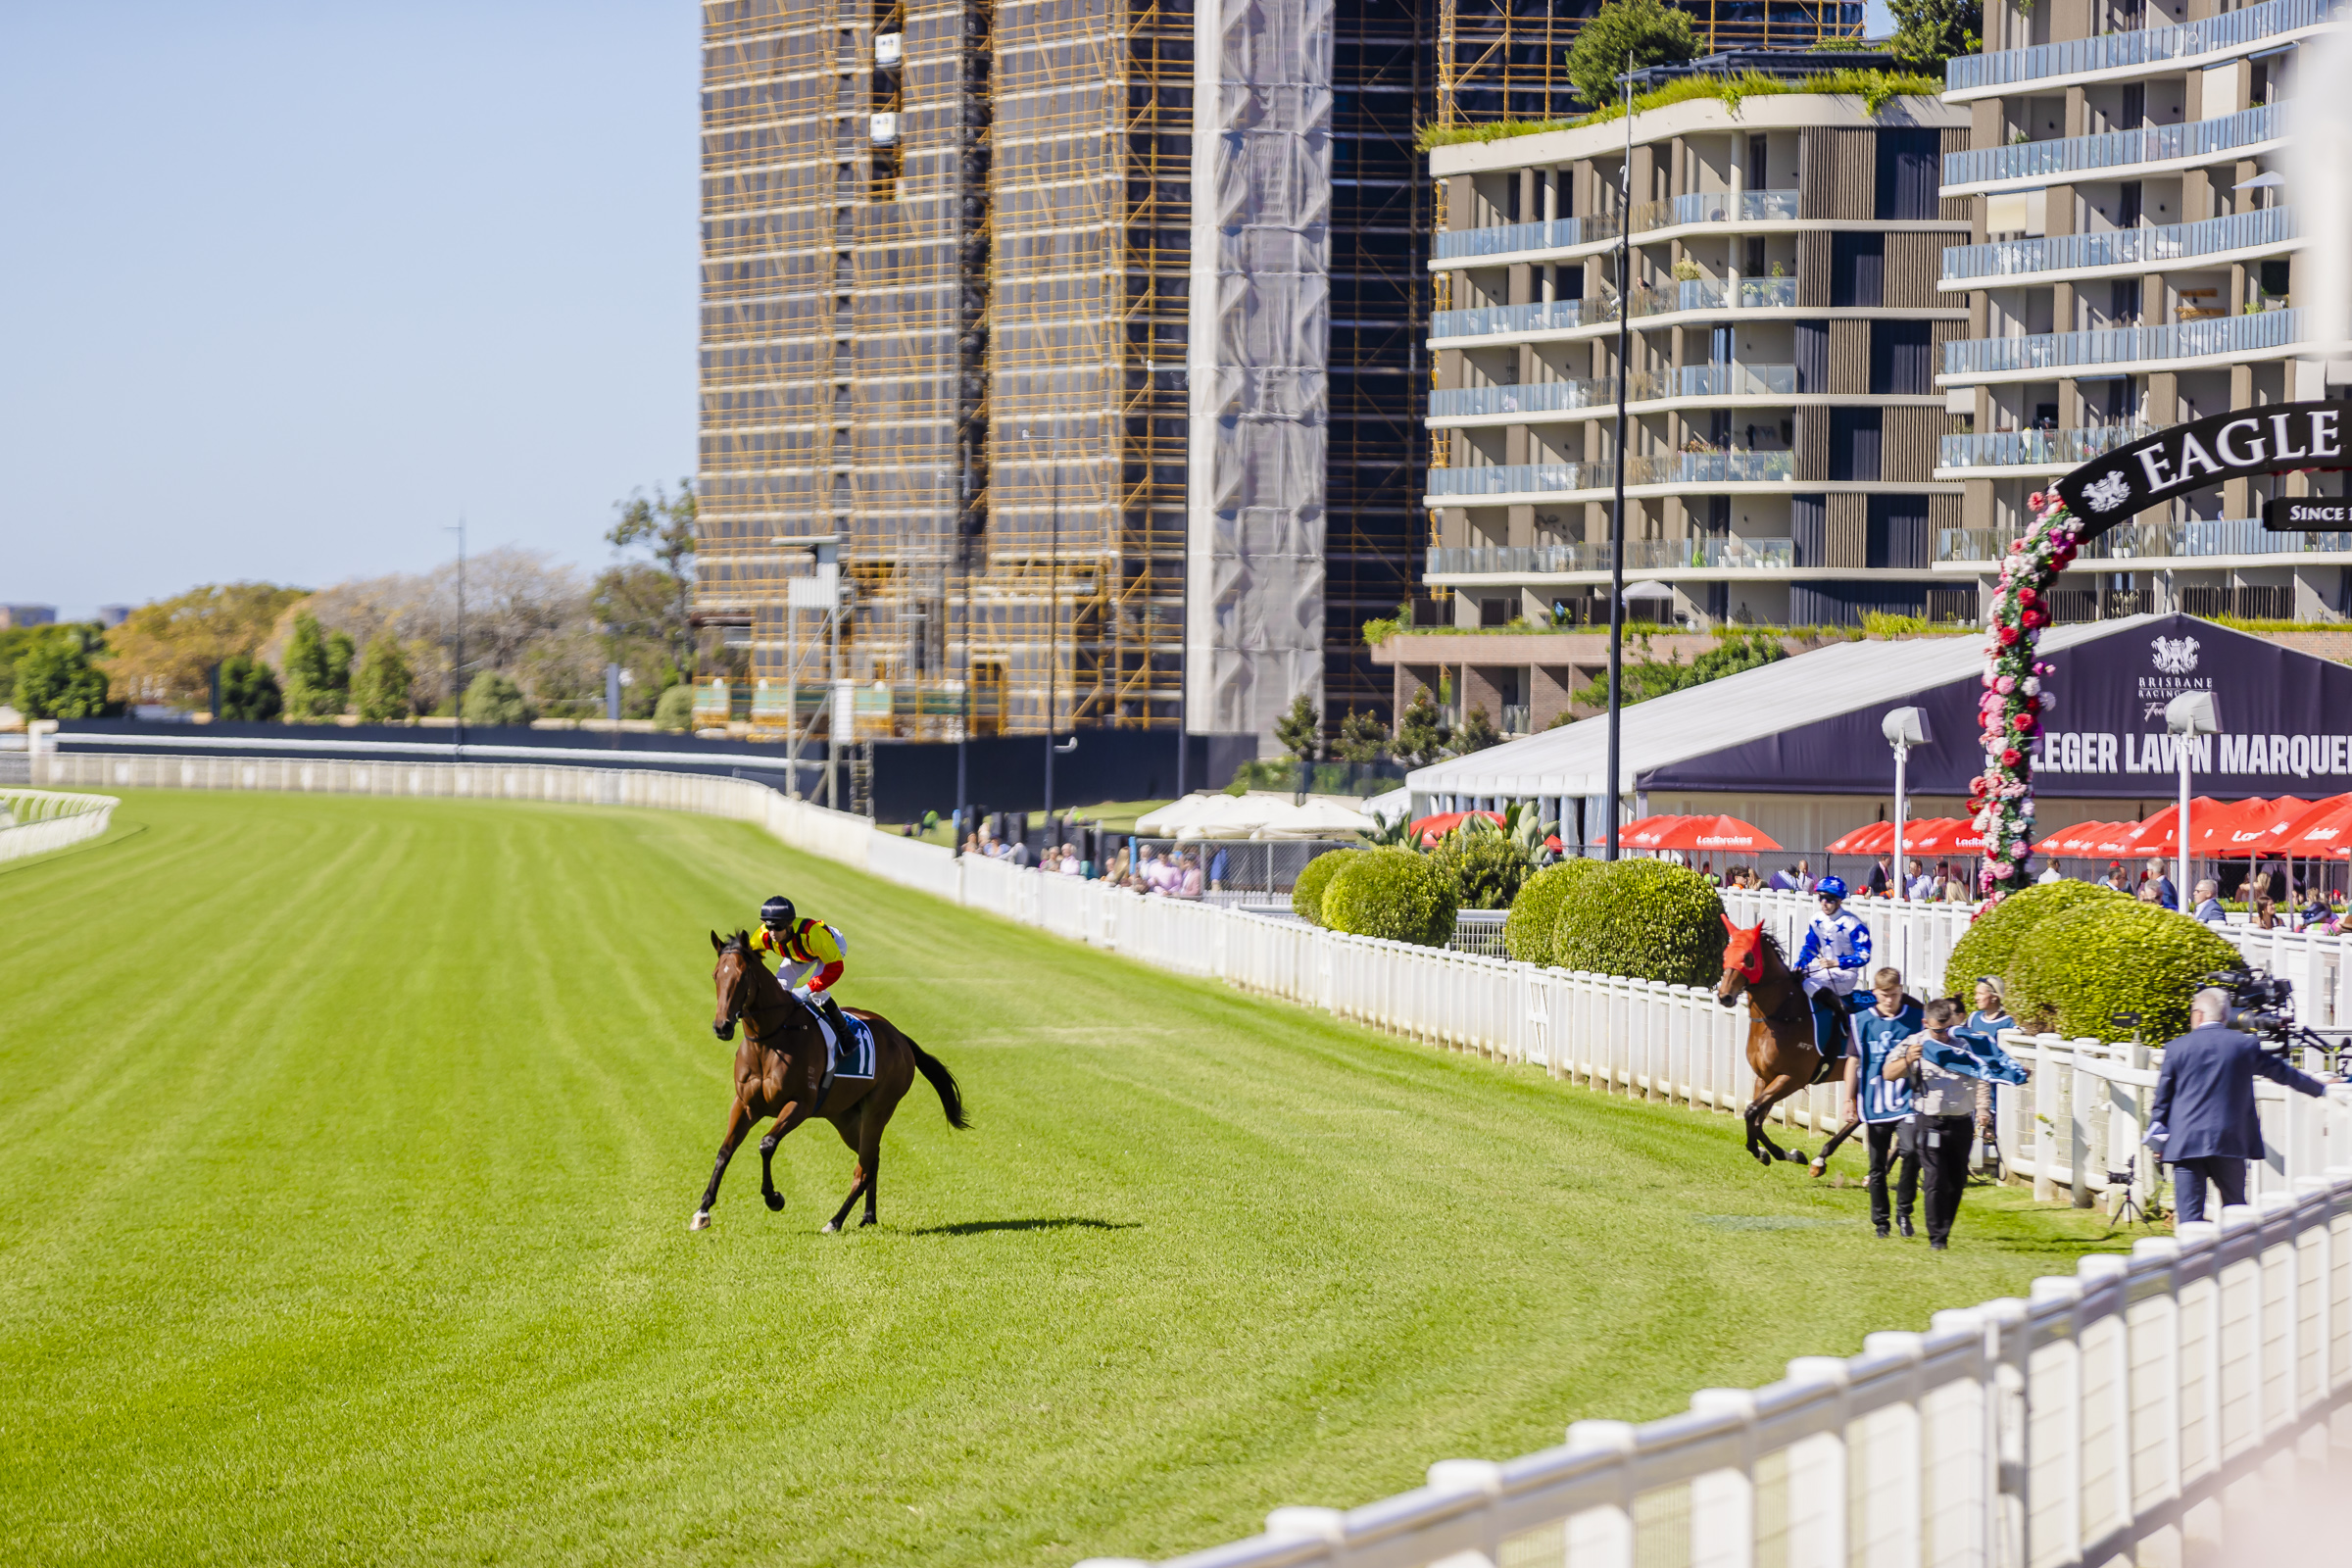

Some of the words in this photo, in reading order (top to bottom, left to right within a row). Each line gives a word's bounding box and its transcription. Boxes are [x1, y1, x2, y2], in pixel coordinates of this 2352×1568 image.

[2132, 410, 2340, 494] EAGLE
[2289, 505, 2345, 521] SINCE
[2138, 676, 2213, 688] BRISBANE
[2138, 689, 2180, 699] RACING
[2125, 733, 2212, 774] LAWN
[2219, 734, 2352, 778] MARQUE
[1696, 835, 1752, 846] Ladbrokes
[855, 1028, 873, 1075] 11
